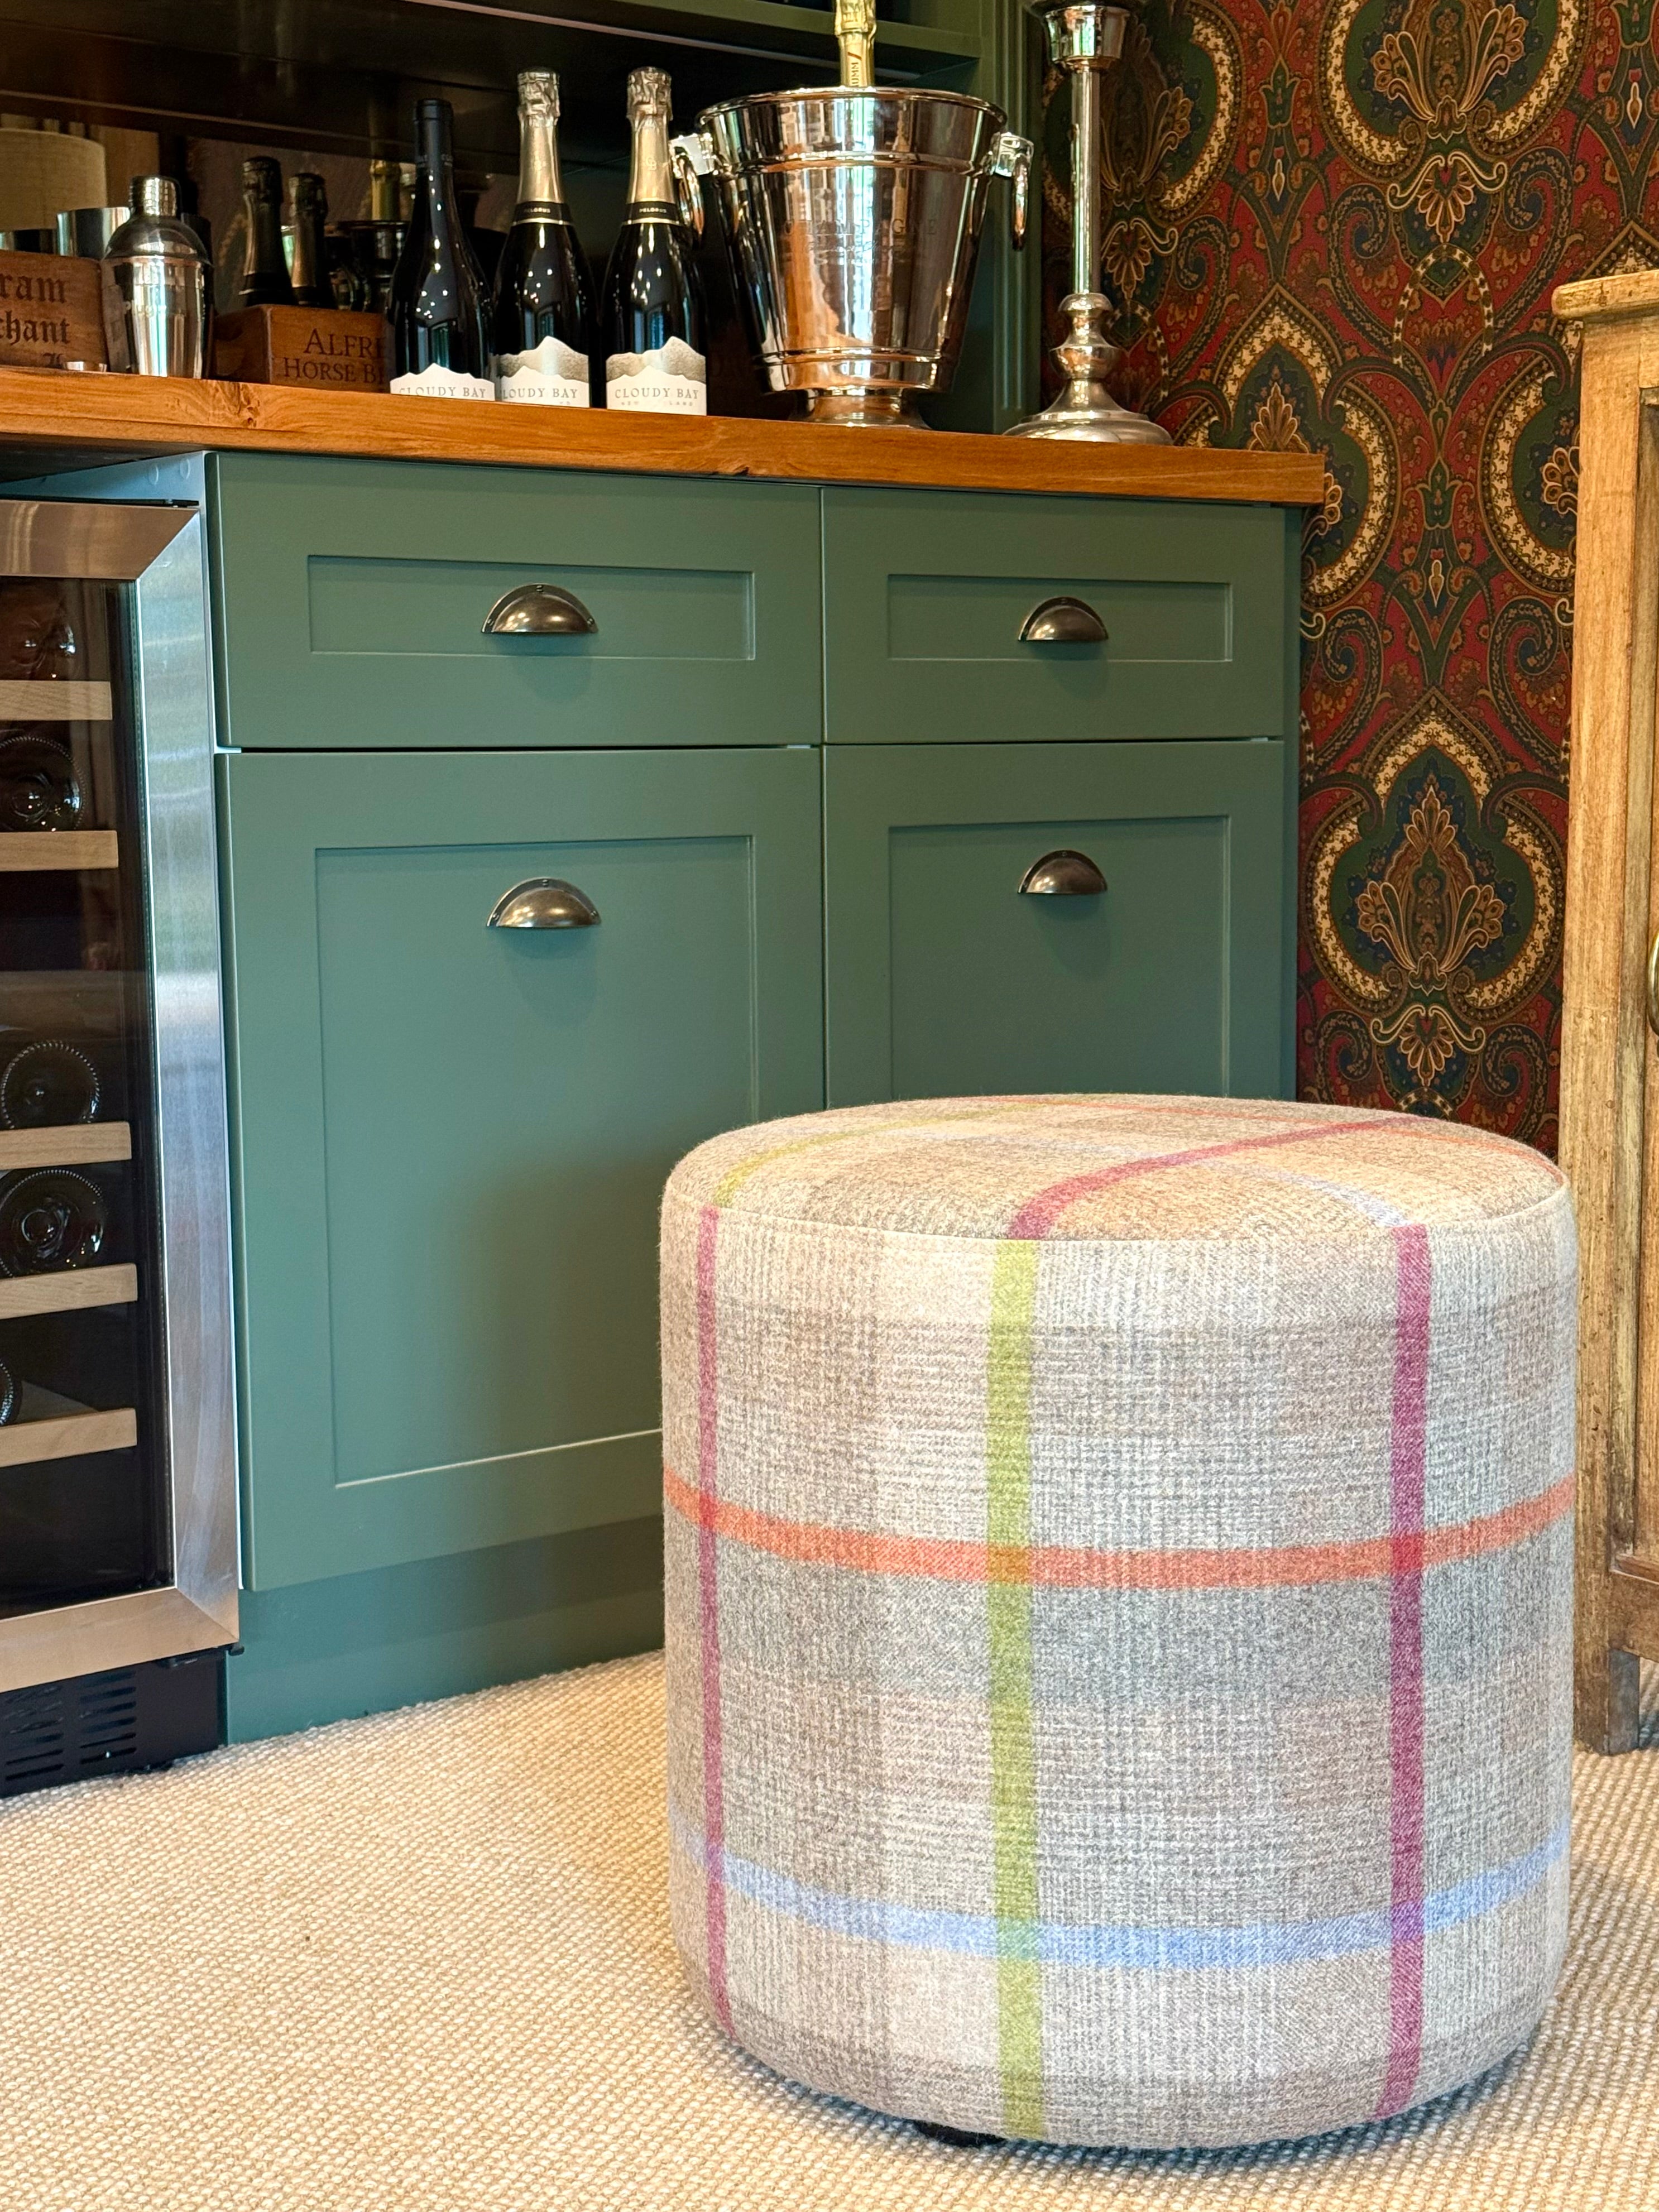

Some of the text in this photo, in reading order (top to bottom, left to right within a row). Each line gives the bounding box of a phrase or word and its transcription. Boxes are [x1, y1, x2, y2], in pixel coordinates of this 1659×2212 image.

[851, 62, 859, 87] UMM
[284, 357, 356, 382] HORSE
[463, 387, 486, 398] BAY
[503, 388, 578, 399] LOUDY BAY
[615, 388, 699, 399] CLOUDY BAY
